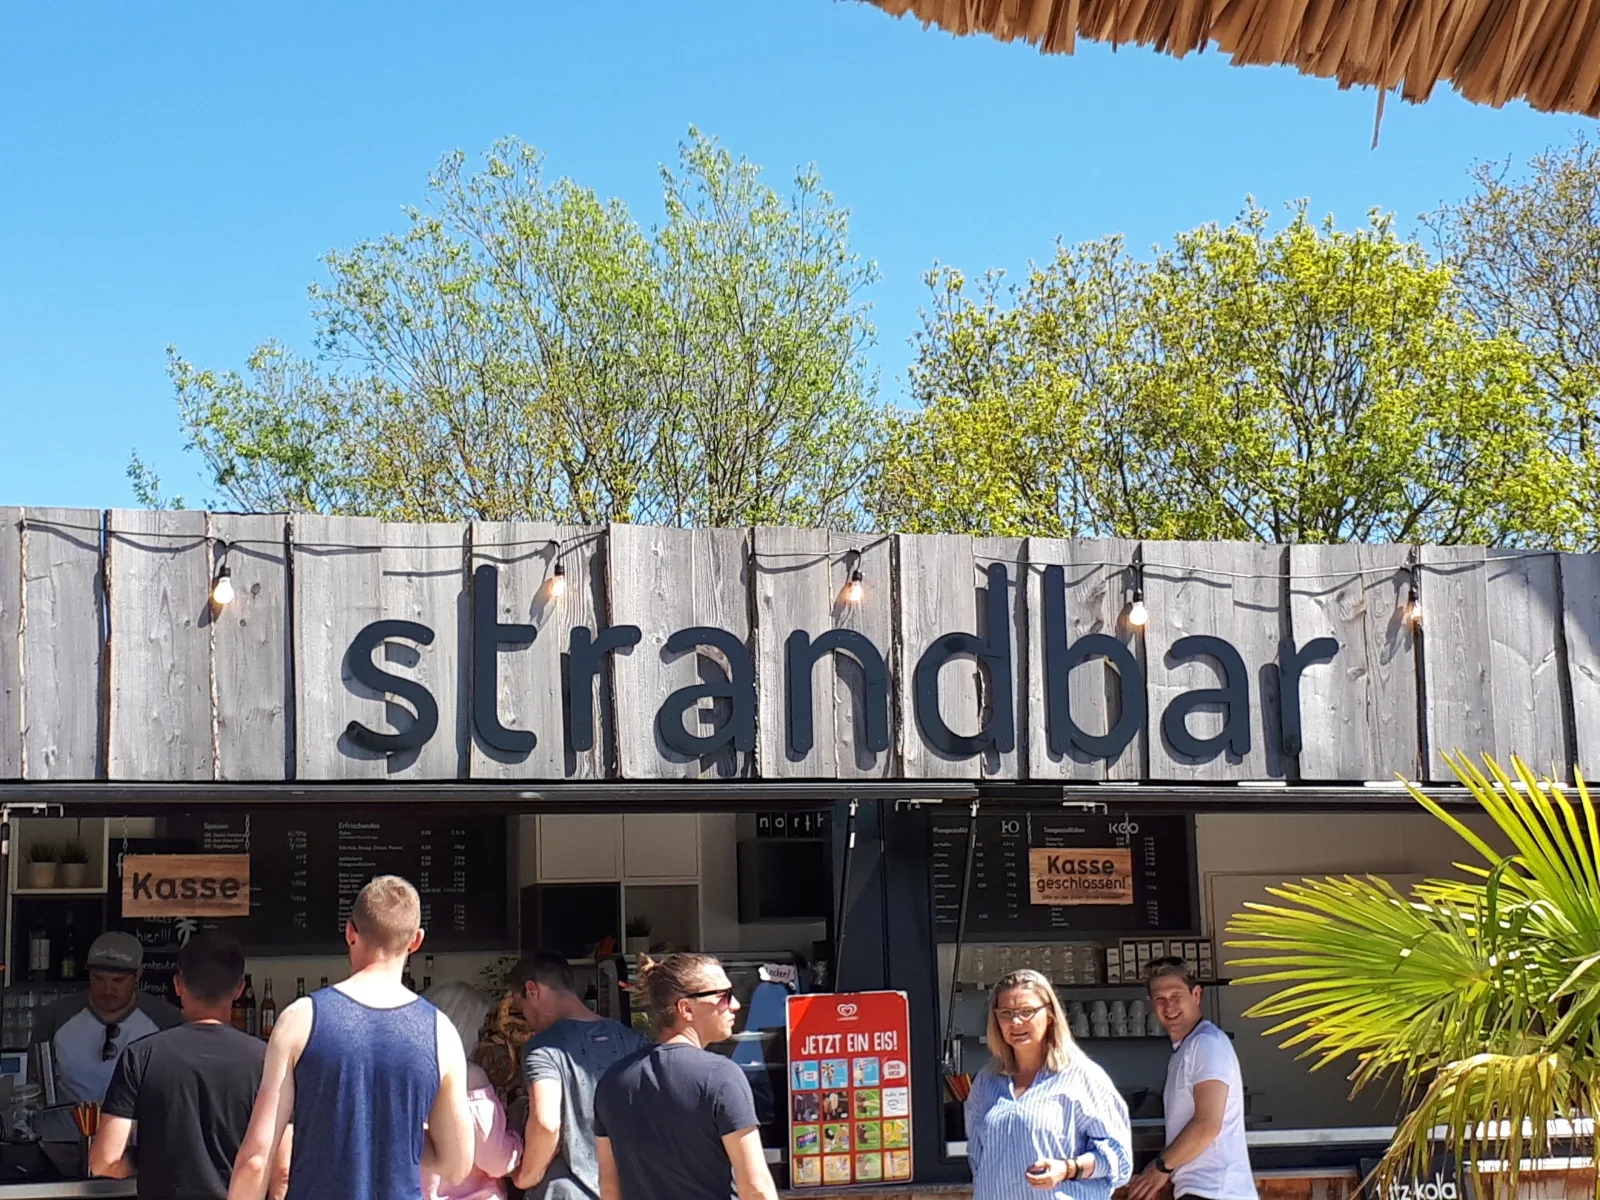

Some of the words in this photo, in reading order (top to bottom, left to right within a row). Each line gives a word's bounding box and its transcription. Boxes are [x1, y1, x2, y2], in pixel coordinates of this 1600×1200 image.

[347, 563, 1339, 757] strandbar
[1047, 855, 1114, 875] Kasse
[132, 872, 240, 900] Kasse
[1036, 877, 1125, 892] geschlossen!
[801, 1034, 842, 1055] JETZT
[847, 1032, 870, 1053] EIN
[874, 1030, 898, 1051] EIS!
